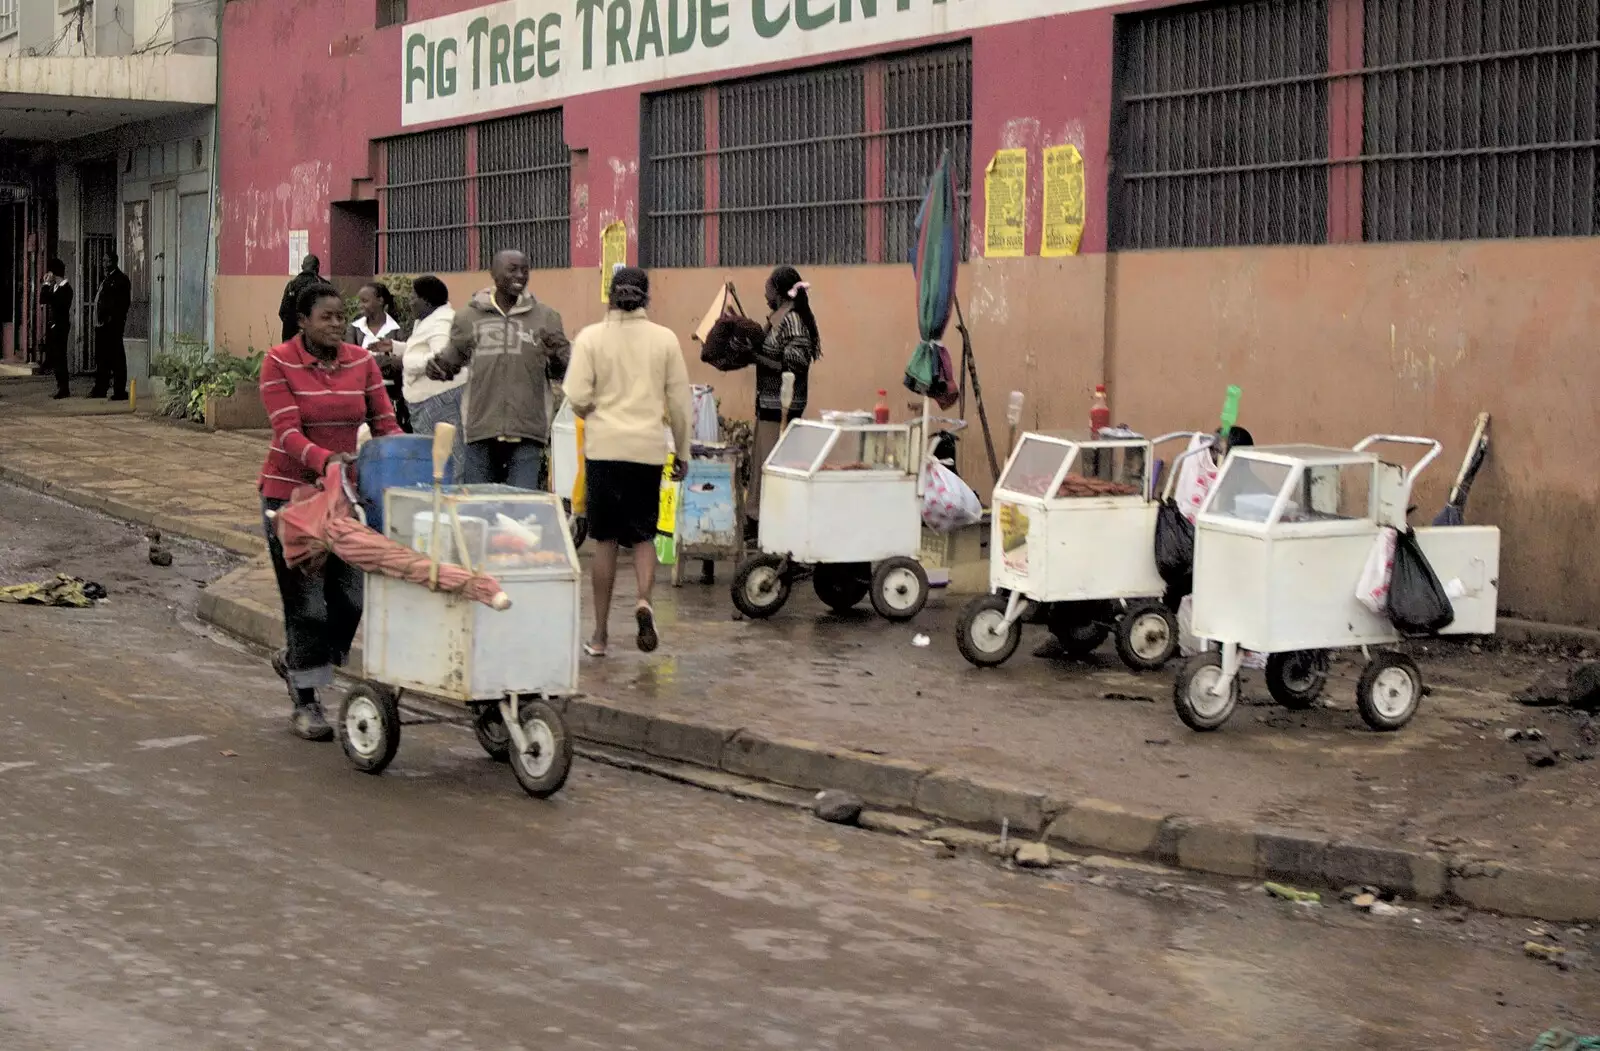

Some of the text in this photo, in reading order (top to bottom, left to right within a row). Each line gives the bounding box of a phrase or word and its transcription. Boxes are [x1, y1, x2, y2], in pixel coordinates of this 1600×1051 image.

[405, 33, 457, 104] FIG
[467, 16, 562, 90] TREE
[575, 0, 730, 70] TRADE
